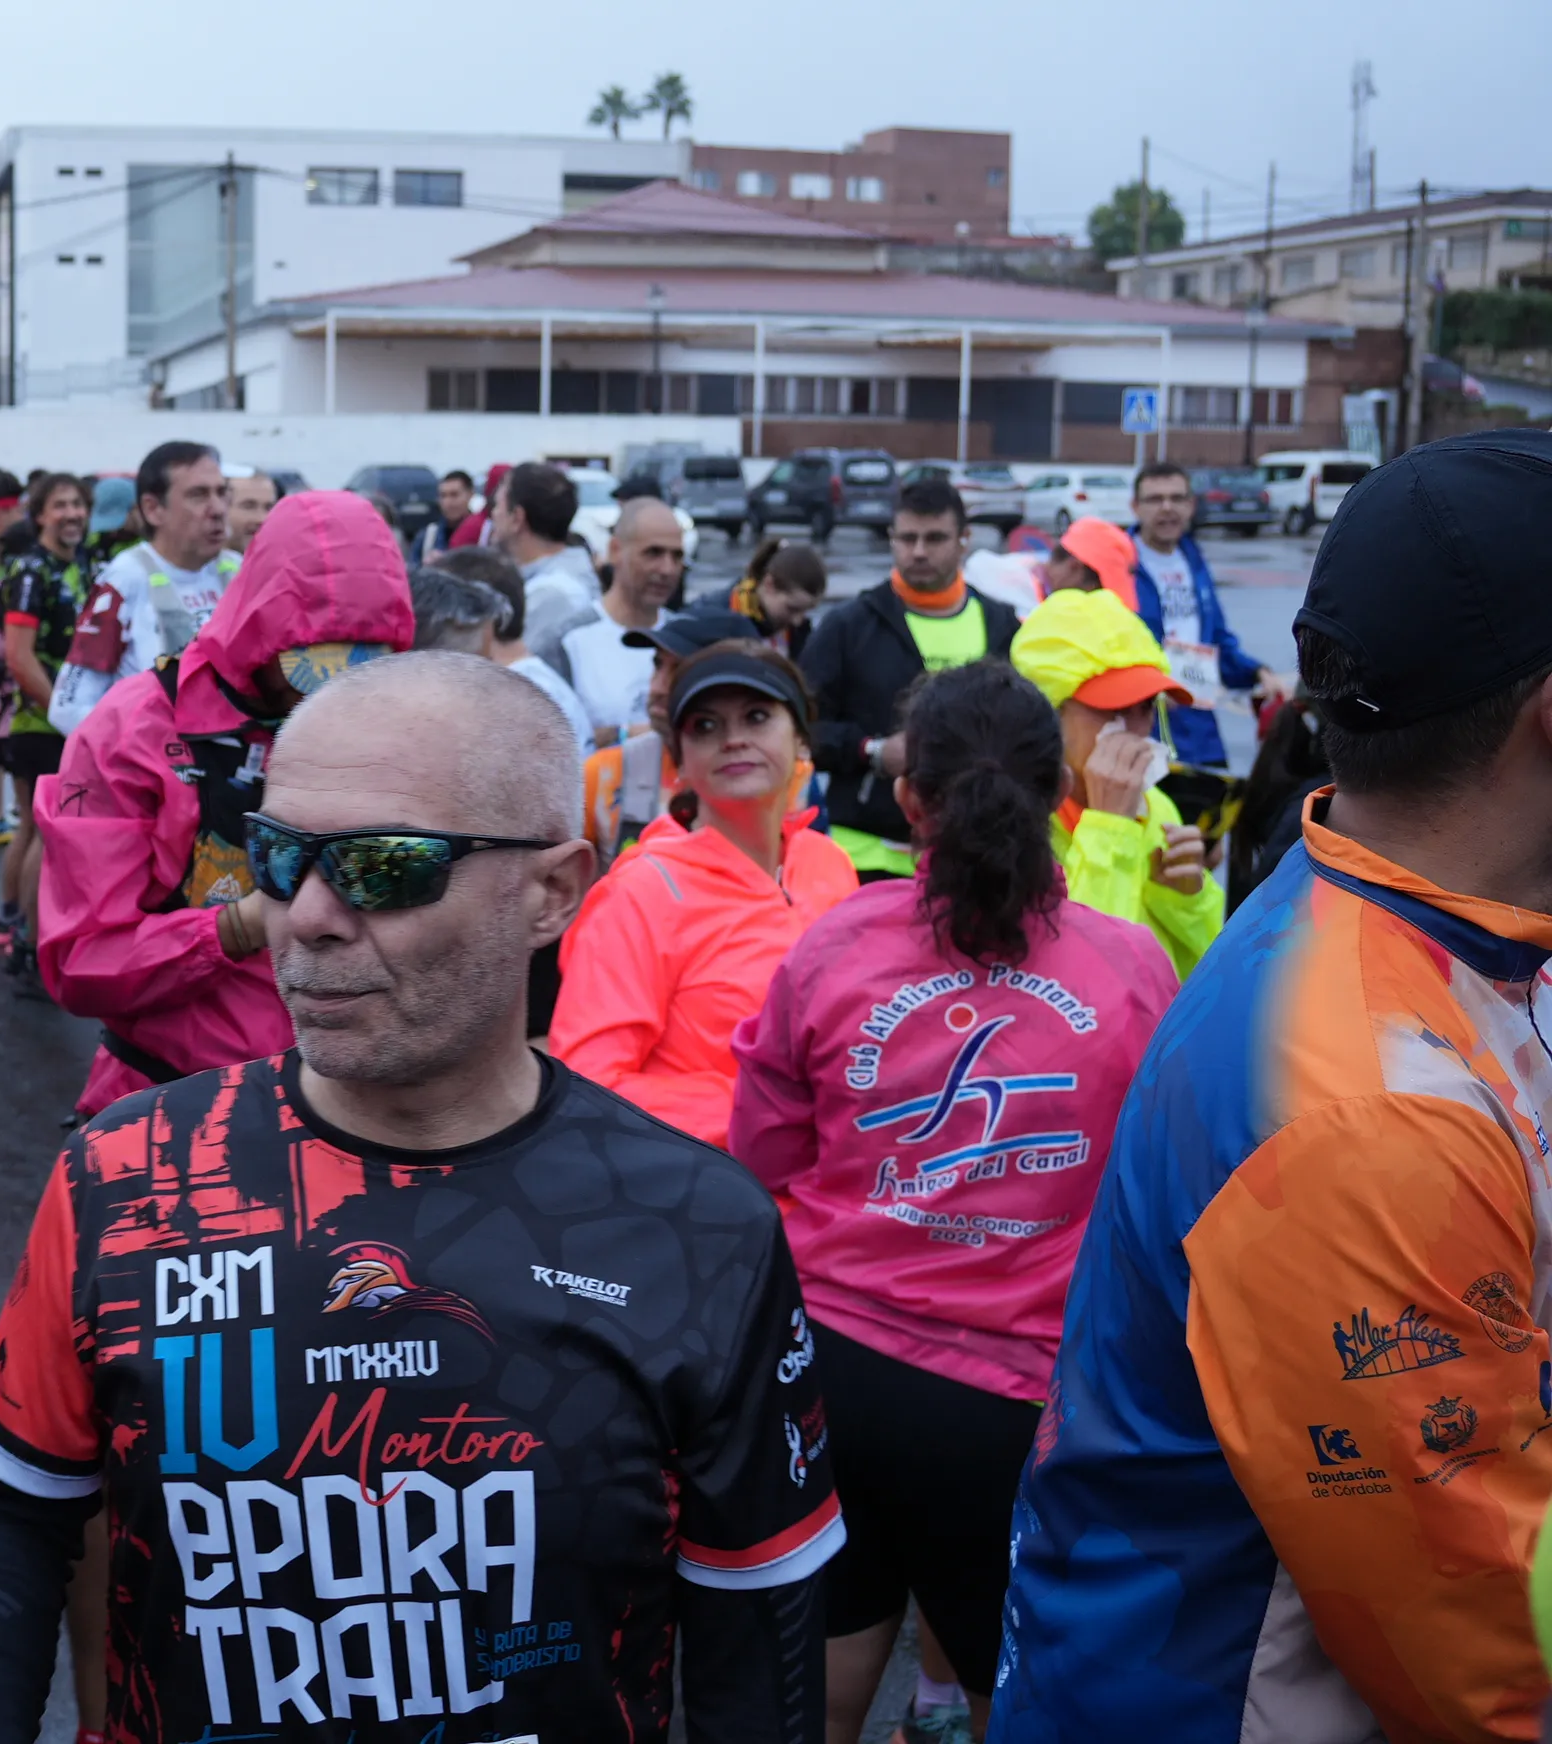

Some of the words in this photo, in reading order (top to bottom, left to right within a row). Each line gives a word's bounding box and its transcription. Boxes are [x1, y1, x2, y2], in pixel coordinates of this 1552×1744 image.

[861, 970, 973, 1041] Atletismo
[988, 963, 1097, 1033] Pontanés
[847, 1045, 880, 1088] Club
[966, 1154, 1006, 1181] del
[1017, 1139, 1089, 1171] Canal
[930, 1230, 983, 1246] 2025
[954, 1214, 967, 1227] A
[156, 1246, 274, 1326] CXM
[555, 1270, 632, 1299] TAKELOT
[1351, 1306, 1392, 1349] Mar
[1394, 1304, 1460, 1358] Alegre
[283, 1387, 544, 1506] Montoro
[1306, 1467, 1386, 1484] Diputación
[1311, 1486, 1329, 1498] de
[1333, 1482, 1392, 1497] Córdoba
[494, 1625, 538, 1653] RUTA
[185, 1599, 504, 1724] TRAIL
